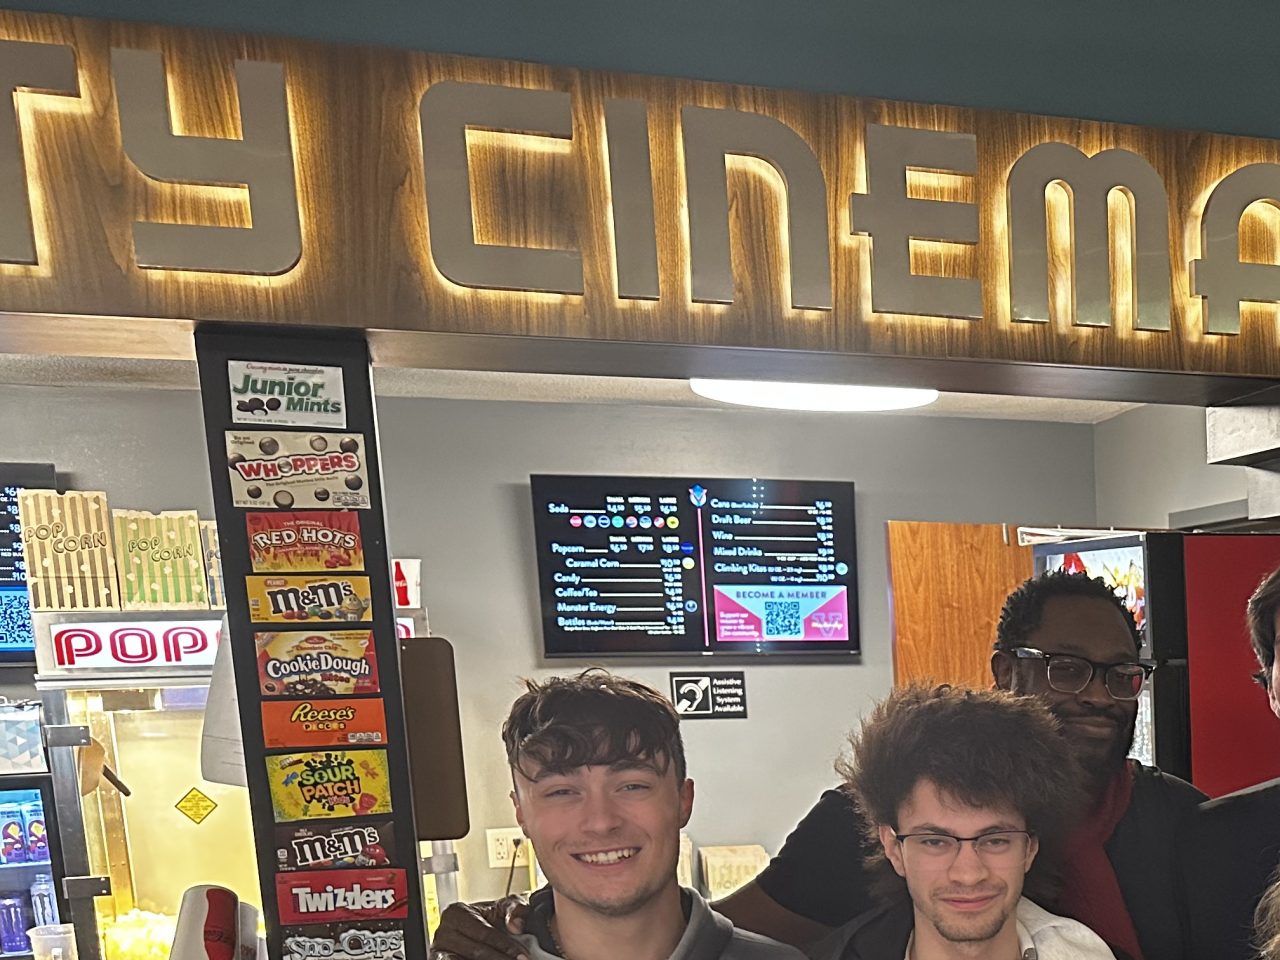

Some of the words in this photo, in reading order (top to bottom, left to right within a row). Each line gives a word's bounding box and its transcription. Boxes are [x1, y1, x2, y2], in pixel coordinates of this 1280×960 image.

[232, 374, 324, 398] Junior
[285, 397, 342, 413] Mints
[238, 454, 358, 478] WHOPPERS
[548, 503, 570, 514] Soda
[711, 514, 733, 525] Draft
[733, 515, 752, 525] Beer
[24, 521, 65, 543] POP
[253, 529, 297, 548] RED
[301, 528, 357, 548] HOTS
[52, 532, 107, 553] CORN
[128, 536, 161, 553] POP
[551, 543, 585, 556] Popcorn
[151, 543, 194, 562] CORN
[565, 558, 599, 568] Caramel
[599, 558, 620, 568] Corn
[553, 572, 581, 585] Candy
[736, 591, 775, 599] BECOME
[787, 591, 827, 599] MEMBER
[556, 603, 589, 612] Monster
[589, 602, 617, 614] Energy
[266, 655, 320, 678] Cookie
[320, 653, 370, 676] Dough
[713, 678, 742, 686] Assistive
[713, 687, 743, 696] Listening
[716, 696, 741, 705] System
[291, 703, 355, 722] Reese's
[714, 705, 745, 713] Available
[301, 765, 355, 785] SOUR
[302, 780, 361, 801] PATCH
[291, 883, 396, 913] Twizzlers
